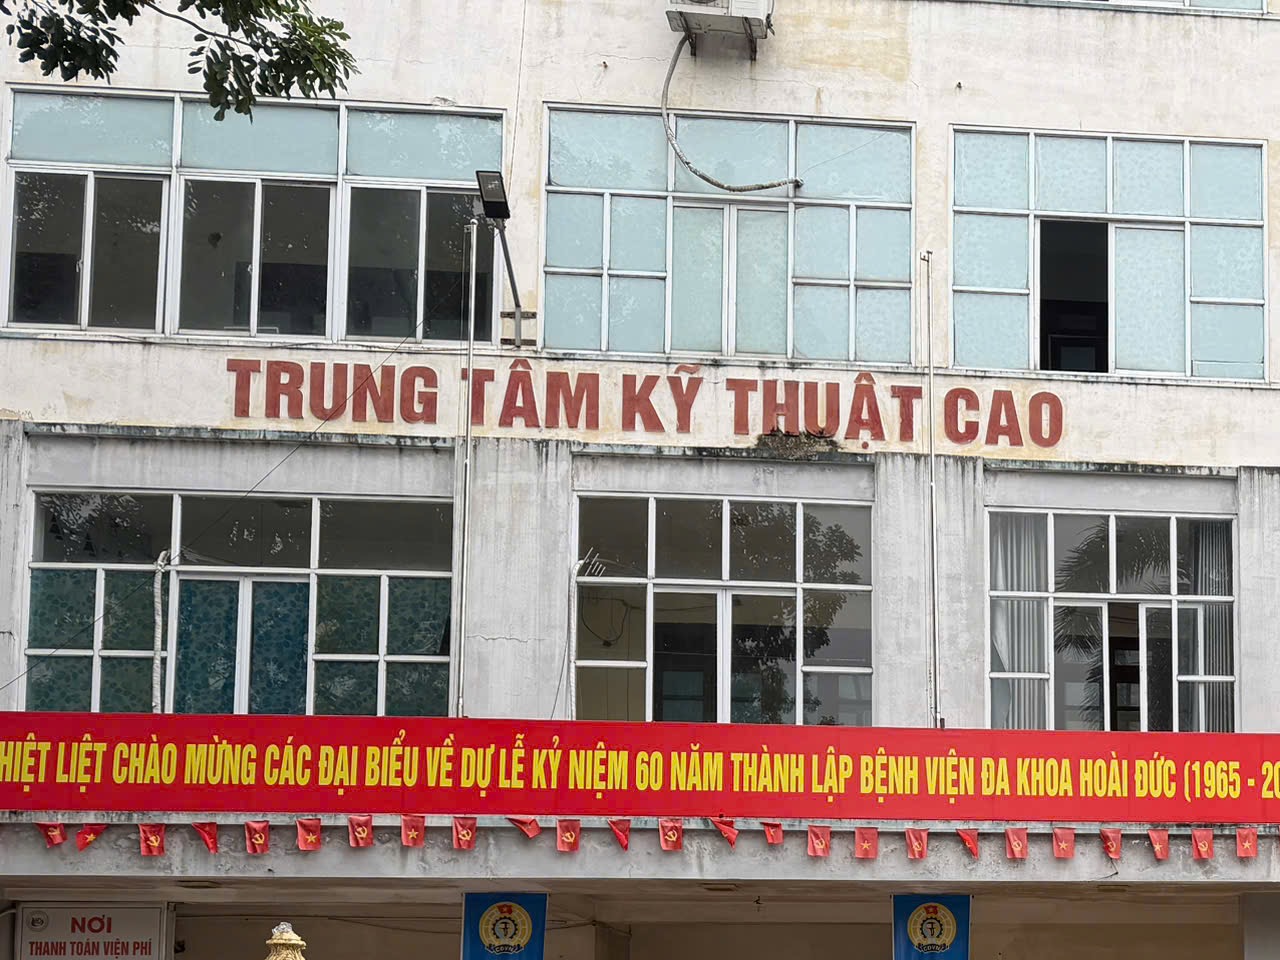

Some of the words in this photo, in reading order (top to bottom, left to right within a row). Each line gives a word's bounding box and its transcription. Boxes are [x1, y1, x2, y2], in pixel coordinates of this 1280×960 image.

[226, 358, 438, 424] TRUNG
[461, 358, 600, 430] TÂM
[621, 363, 703, 433] KỸ
[725, 372, 923, 449] THUẬT
[944, 387, 1062, 448] CAO
[56, 733, 107, 793] LIỆT
[112, 734, 177, 784] CHÀO
[184, 735, 257, 785] MỪNG
[264, 736, 312, 785] CÁC
[319, 745, 359, 796] ĐẠI
[365, 729, 419, 787] BIỂU
[426, 733, 454, 788] VỀ
[460, 743, 496, 797] DỰ
[499, 733, 525, 788] LỄ
[532, 735, 562, 789] KỶ
[568, 741, 628, 799] NIỆM
[635, 751, 663, 791] 60
[670, 743, 723, 791] NĂM
[731, 744, 805, 793] THÀNH
[811, 745, 853, 802] LẬP
[860, 747, 919, 803] BỆNH
[925, 748, 974, 804] VIỆN
[981, 757, 1010, 796] ĐA
[1016, 757, 1074, 797] KHOA
[1079, 751, 1128, 797] HOÀI
[1134, 751, 1176, 798] ĐỨC
[1184, 760, 1241, 802] (1965
[70, 914, 112, 934] NƠI
[29, 941, 66, 956] THANH
[70, 938, 99, 956] TOÁN
[103, 938, 129, 959] VIỆN
[133, 938, 152, 956] PHÍ
